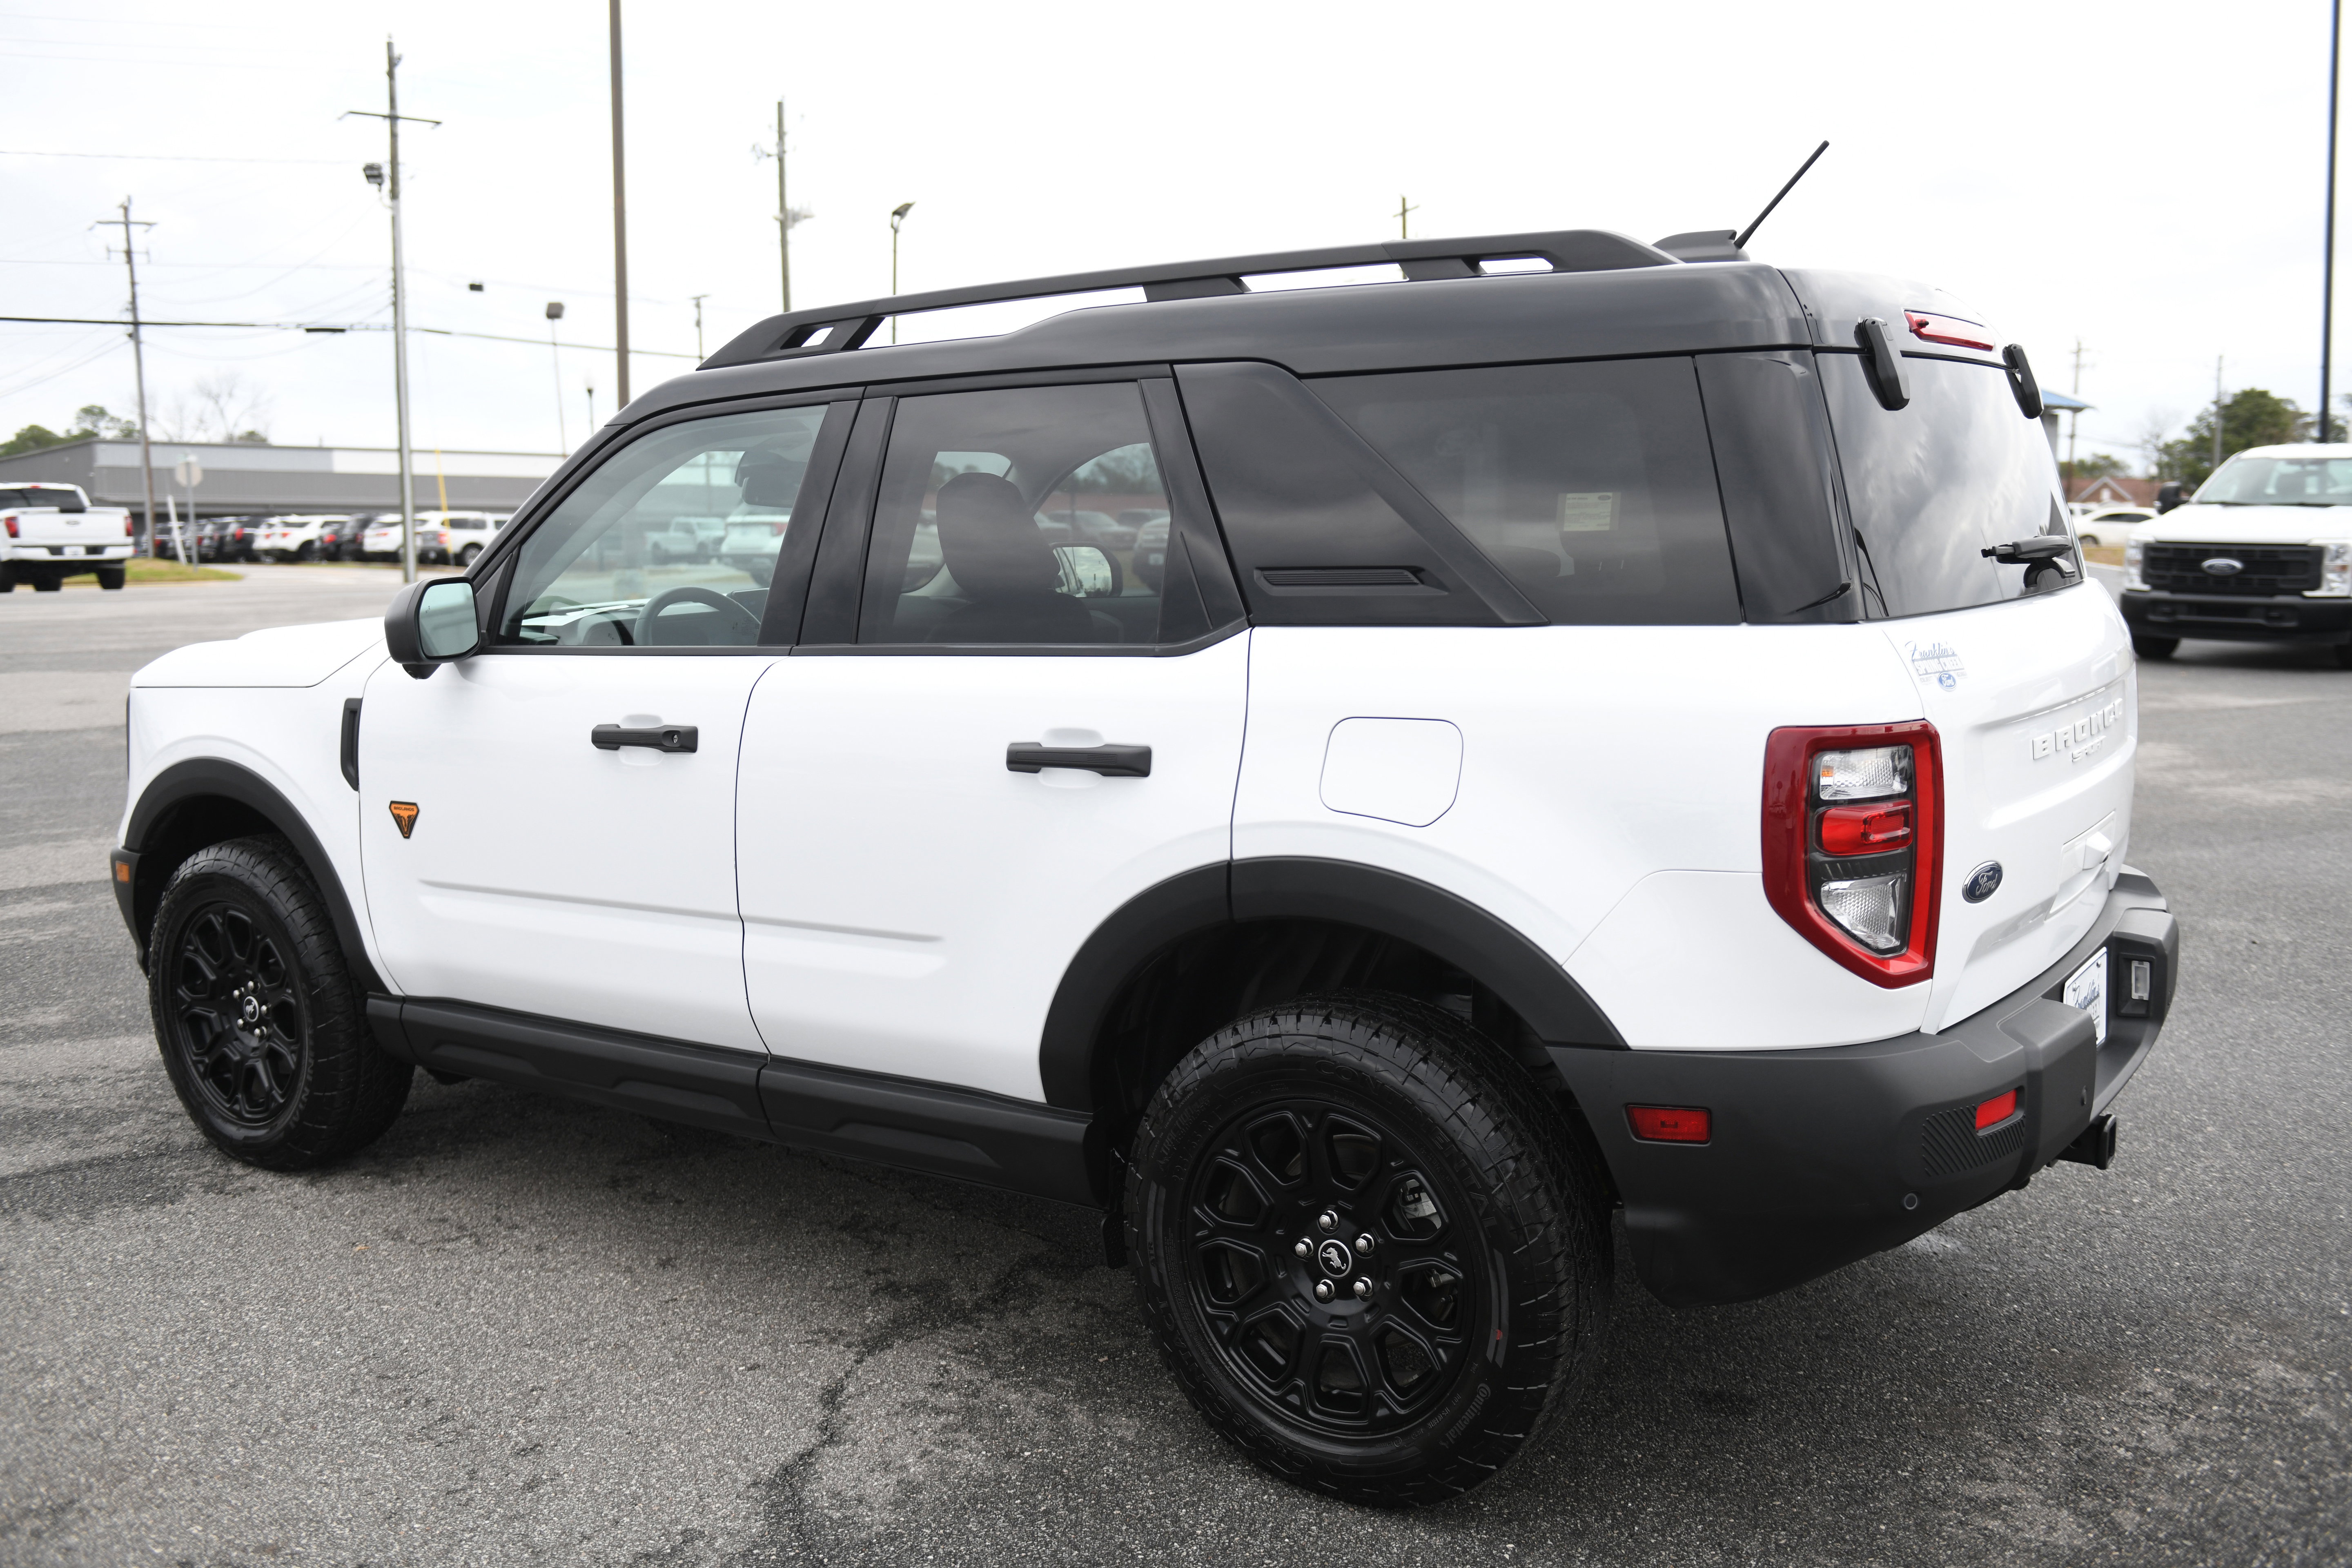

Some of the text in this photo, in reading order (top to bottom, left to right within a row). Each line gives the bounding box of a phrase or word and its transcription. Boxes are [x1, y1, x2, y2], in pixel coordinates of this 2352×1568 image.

[1904, 641, 1955, 661] Franklin's
[1941, 674, 1955, 686] Ford
[2032, 698, 2123, 760] BRONCO
[1976, 871, 1998, 896] Ford
[1314, 1060, 1497, 1238] CONTINENTAL
[1445, 1383, 1491, 1444] Continental
